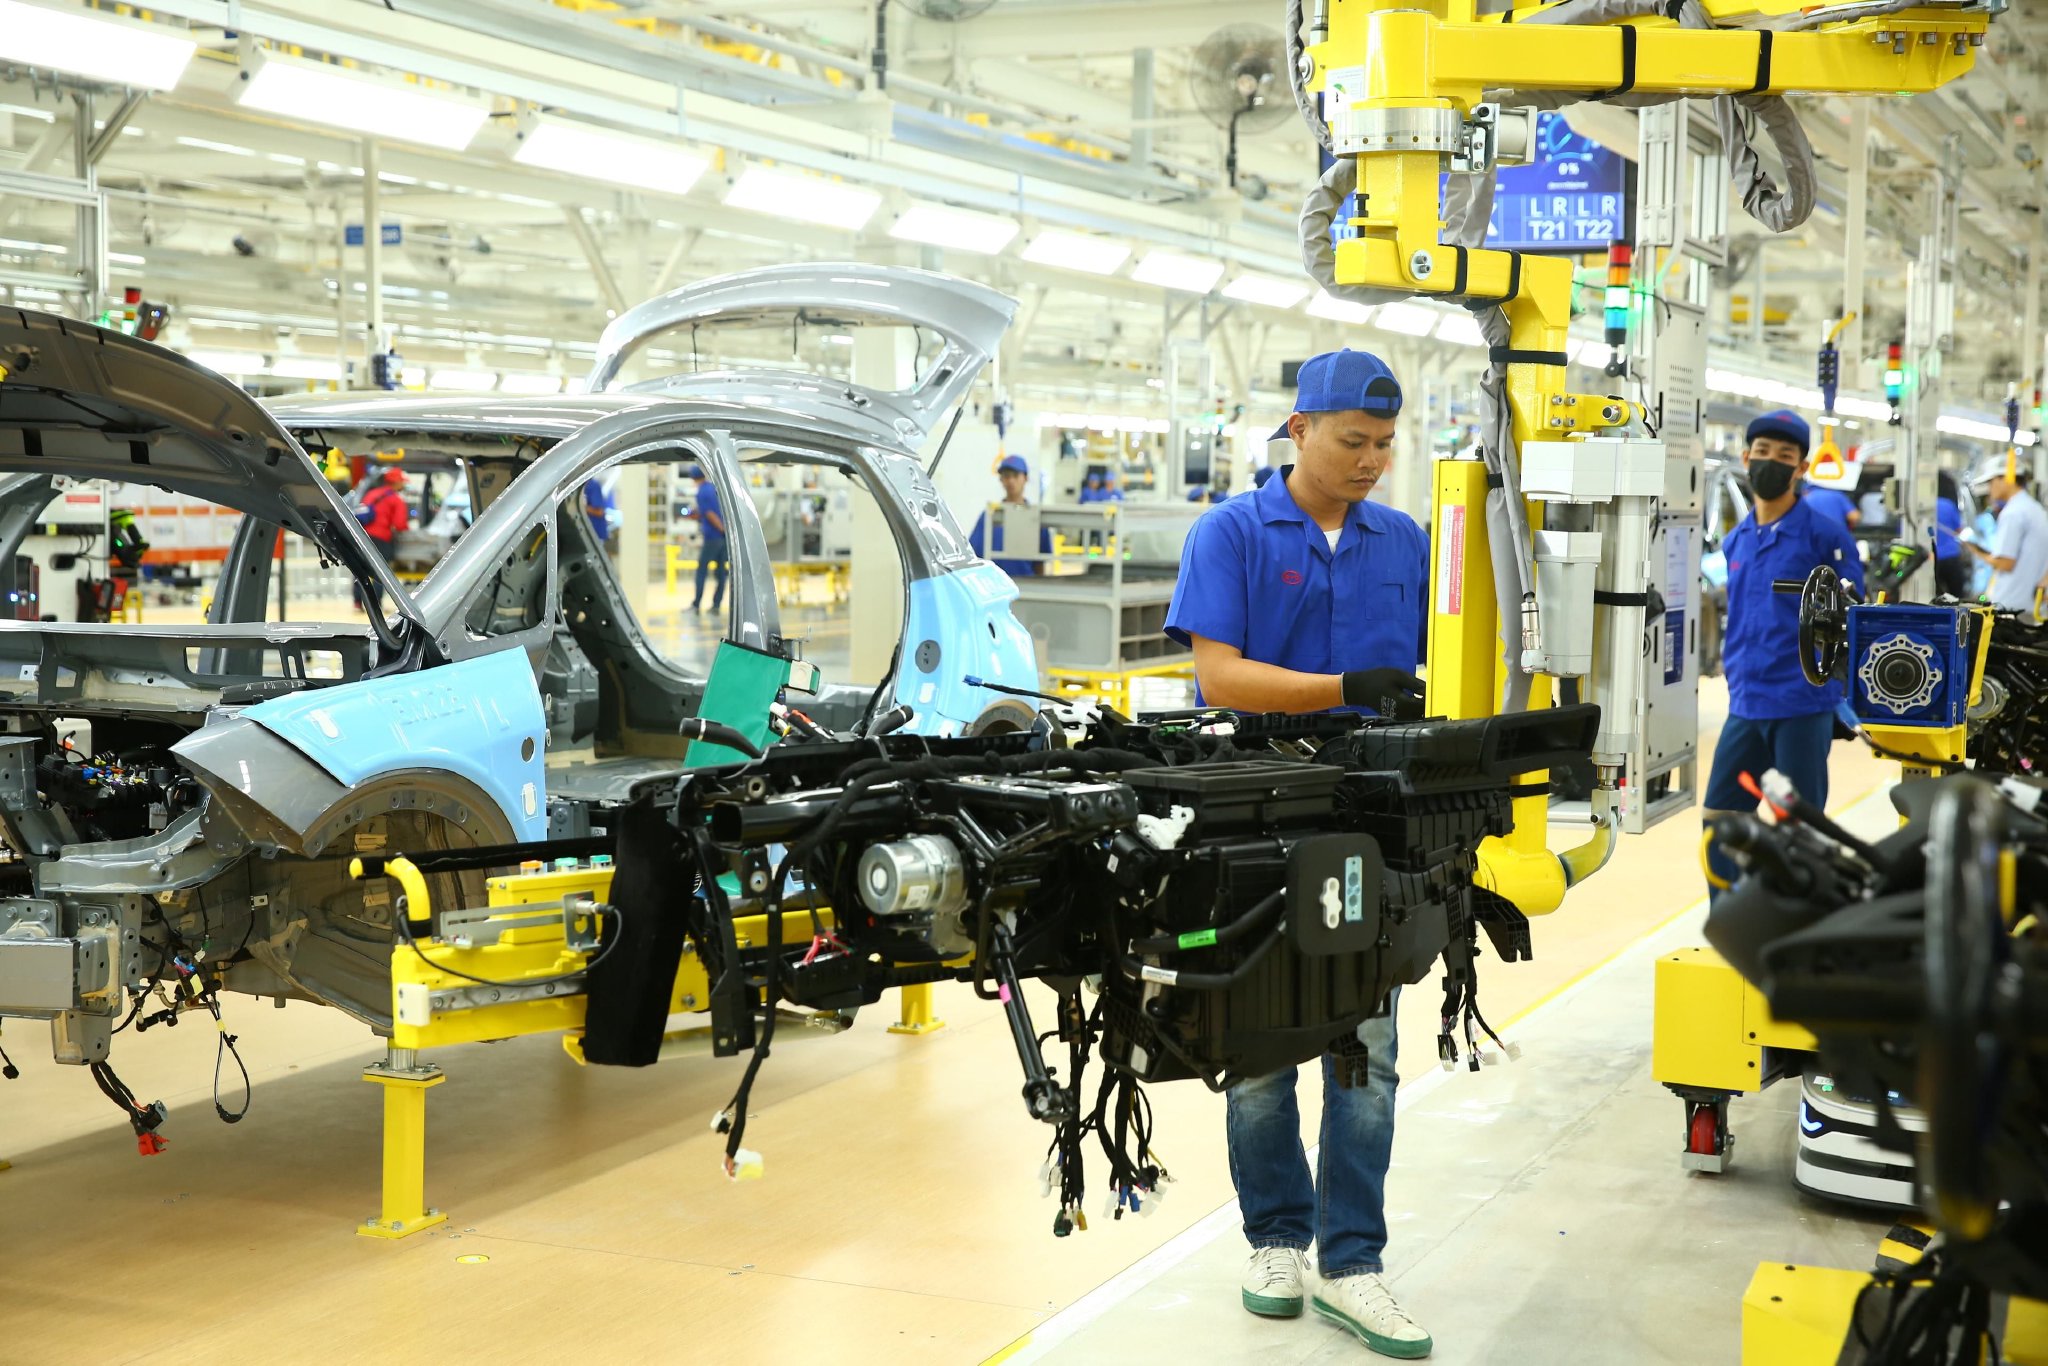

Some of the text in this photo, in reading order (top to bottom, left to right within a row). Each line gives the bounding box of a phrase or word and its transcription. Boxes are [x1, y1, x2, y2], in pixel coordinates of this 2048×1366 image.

[1531, 195, 1616, 217] L R L R
[1528, 219, 1614, 240] T21 T22
